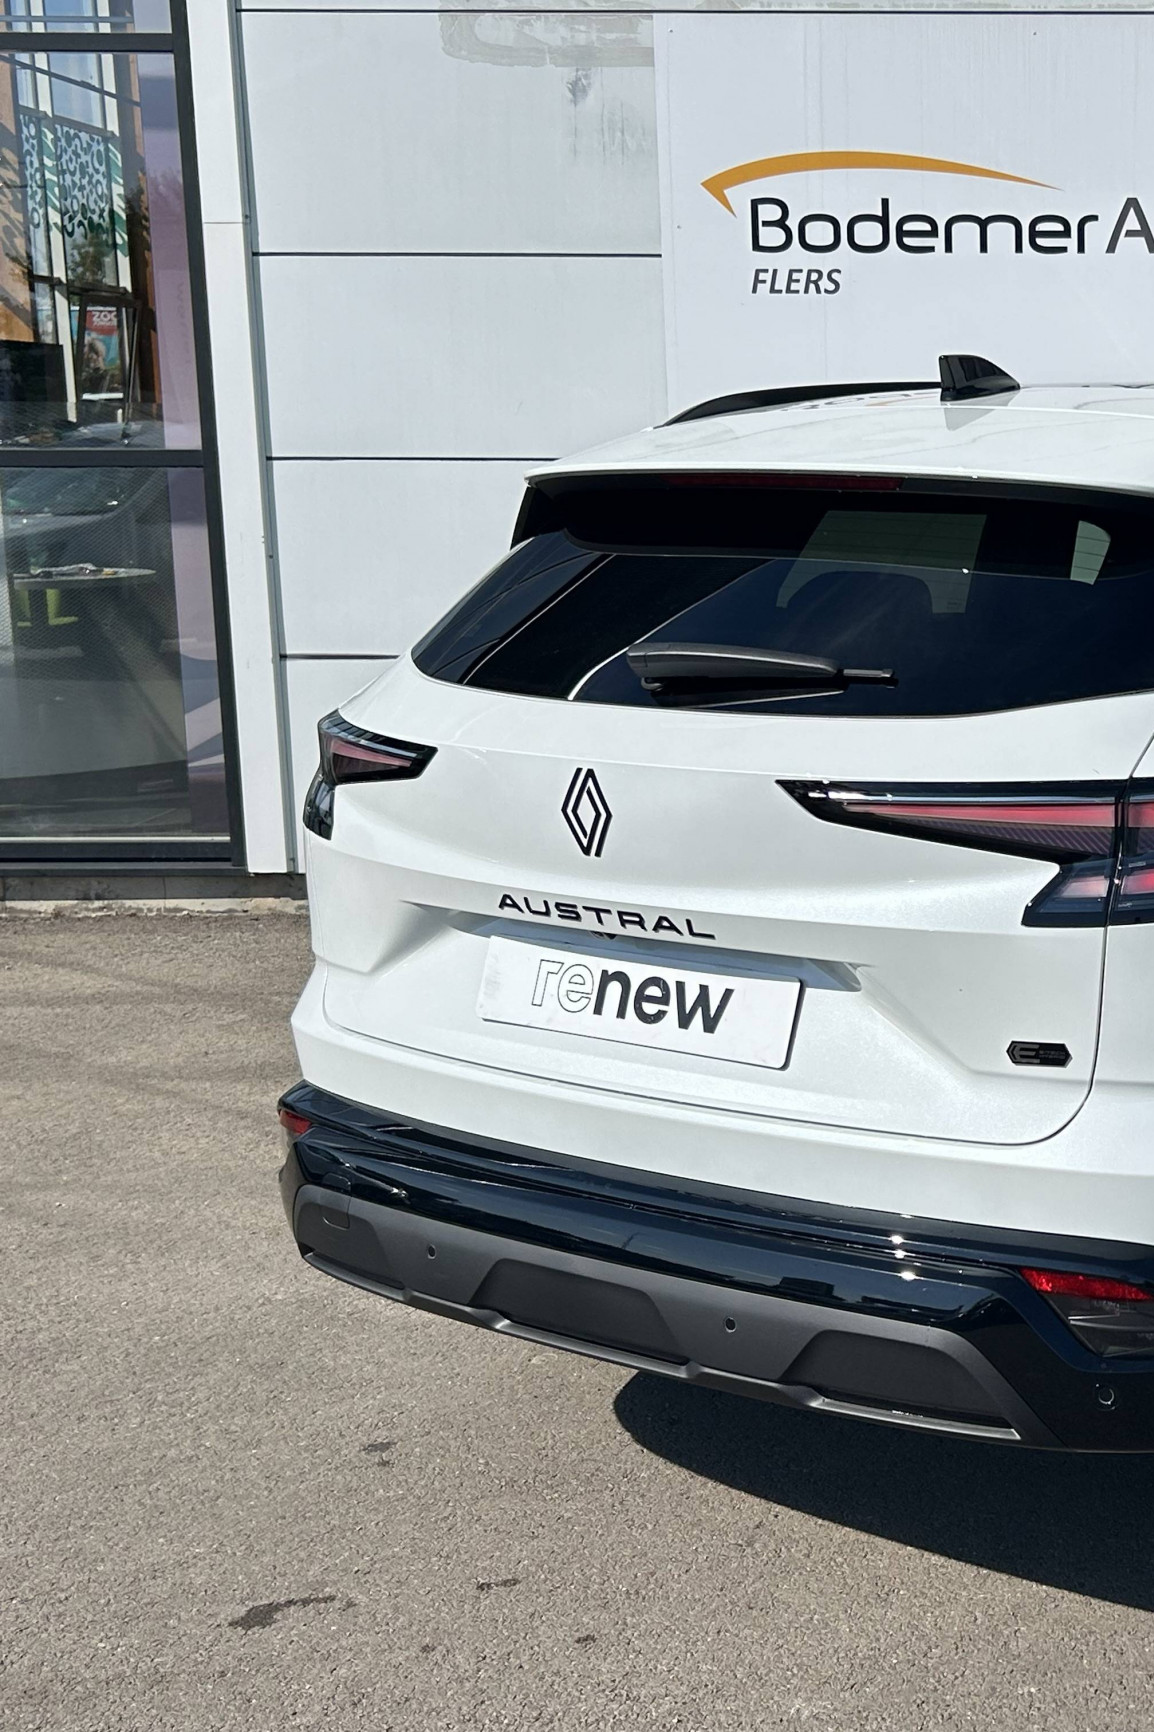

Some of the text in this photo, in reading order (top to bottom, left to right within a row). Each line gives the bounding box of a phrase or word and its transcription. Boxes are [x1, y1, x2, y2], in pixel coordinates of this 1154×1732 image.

[751, 268, 842, 295] FLERS
[498, 893, 717, 940] AUSTRAL
[531, 958, 735, 1035] renew
